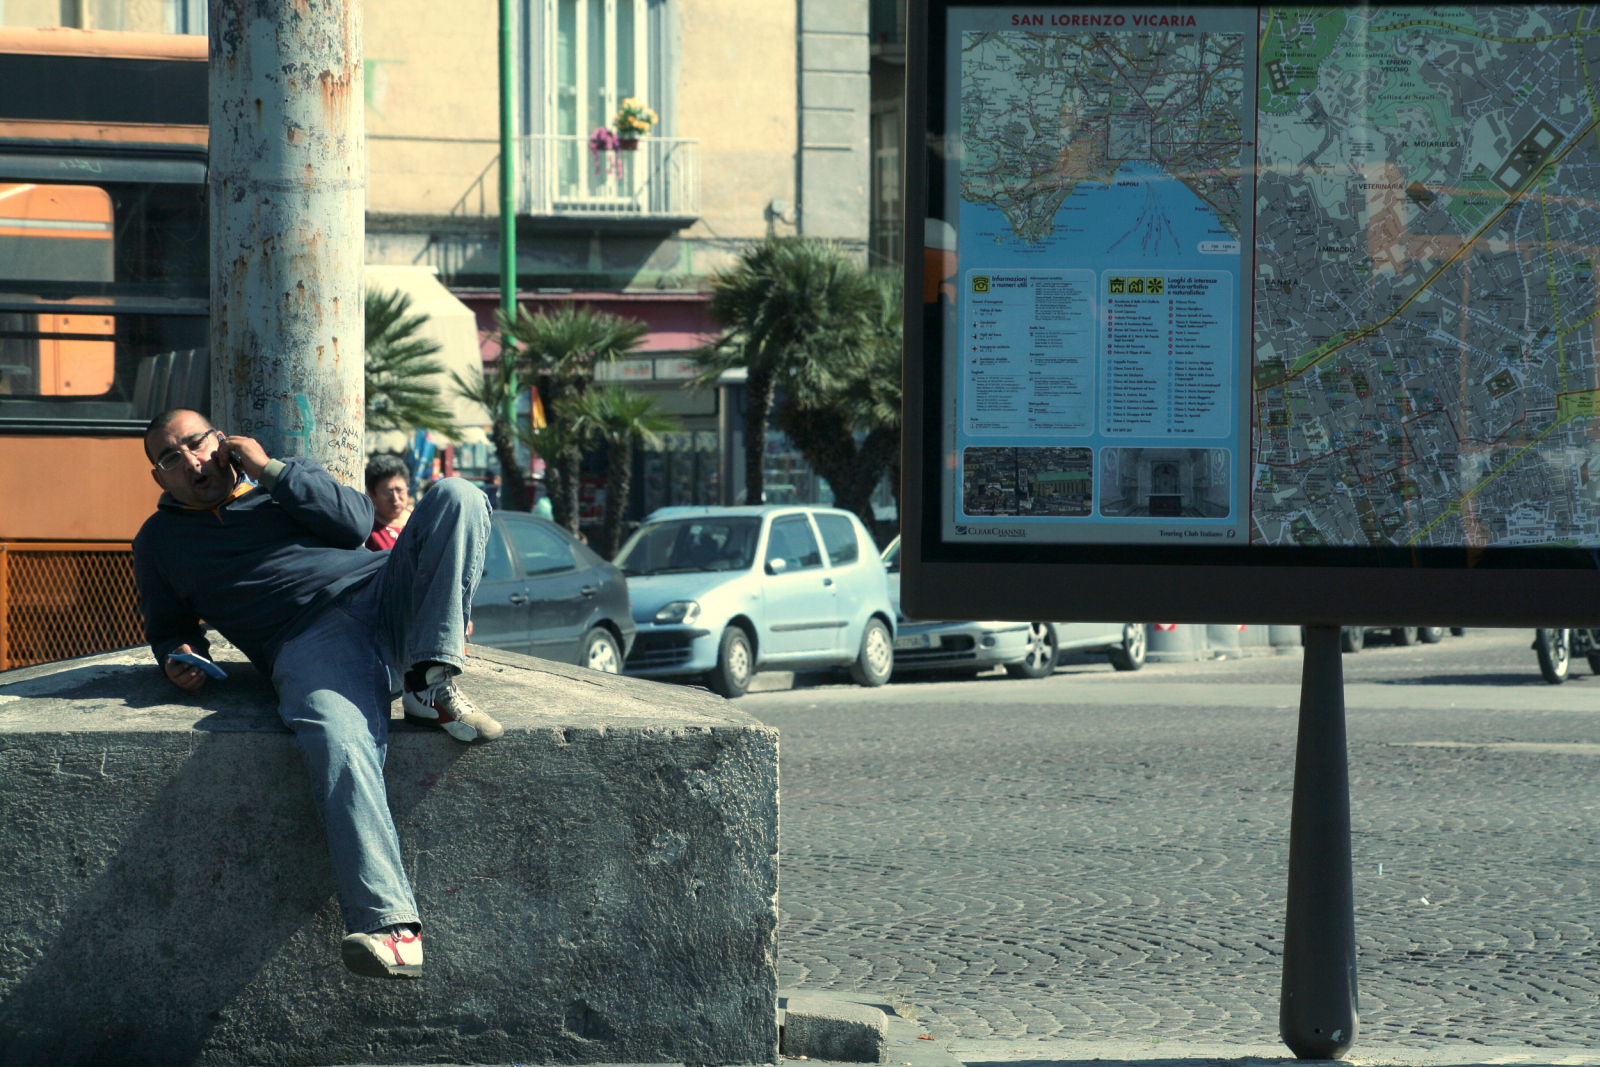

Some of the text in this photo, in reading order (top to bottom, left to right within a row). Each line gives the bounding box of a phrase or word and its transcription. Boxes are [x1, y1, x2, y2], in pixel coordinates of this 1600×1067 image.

[1012, 14, 1196, 26] SAN LORENZO VICARIA
